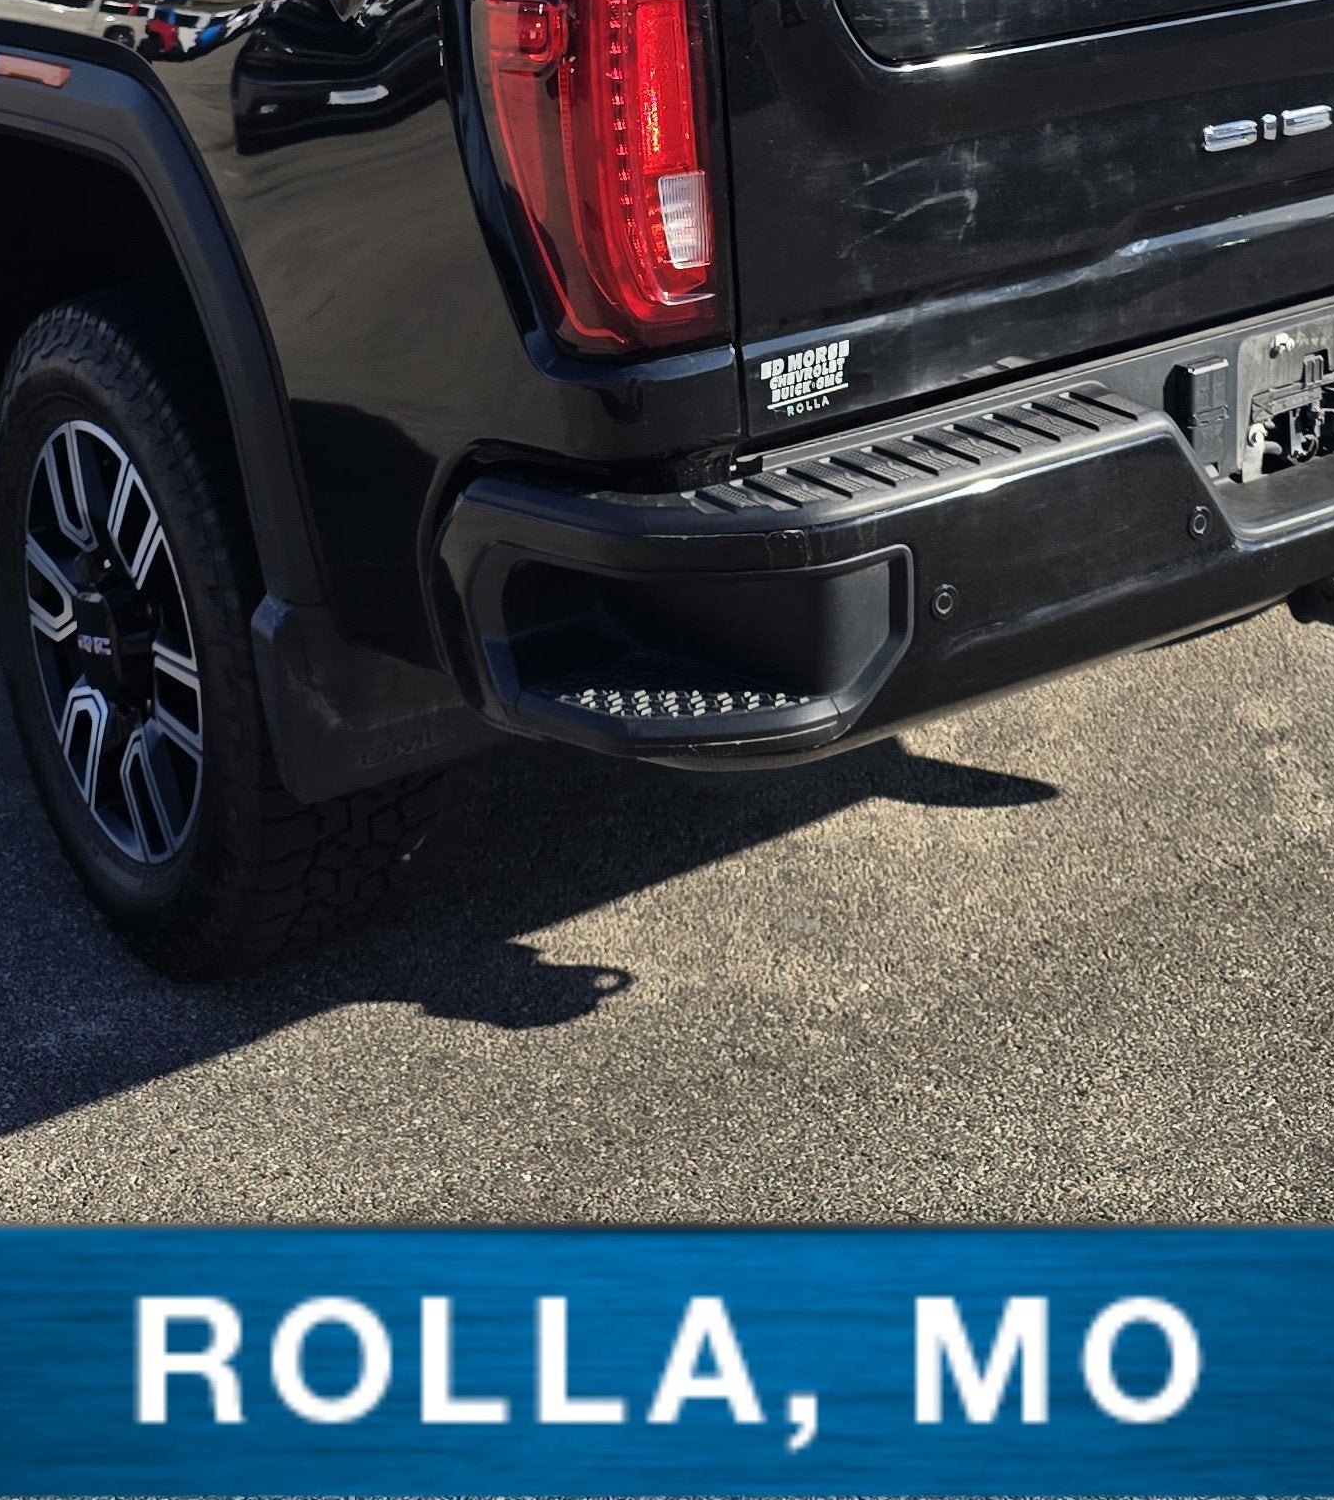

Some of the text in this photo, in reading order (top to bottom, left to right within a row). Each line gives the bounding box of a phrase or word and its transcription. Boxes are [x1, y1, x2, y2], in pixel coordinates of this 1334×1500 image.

[760, 339, 850, 380] ED MORSE
[786, 395, 830, 417] ROLLA
